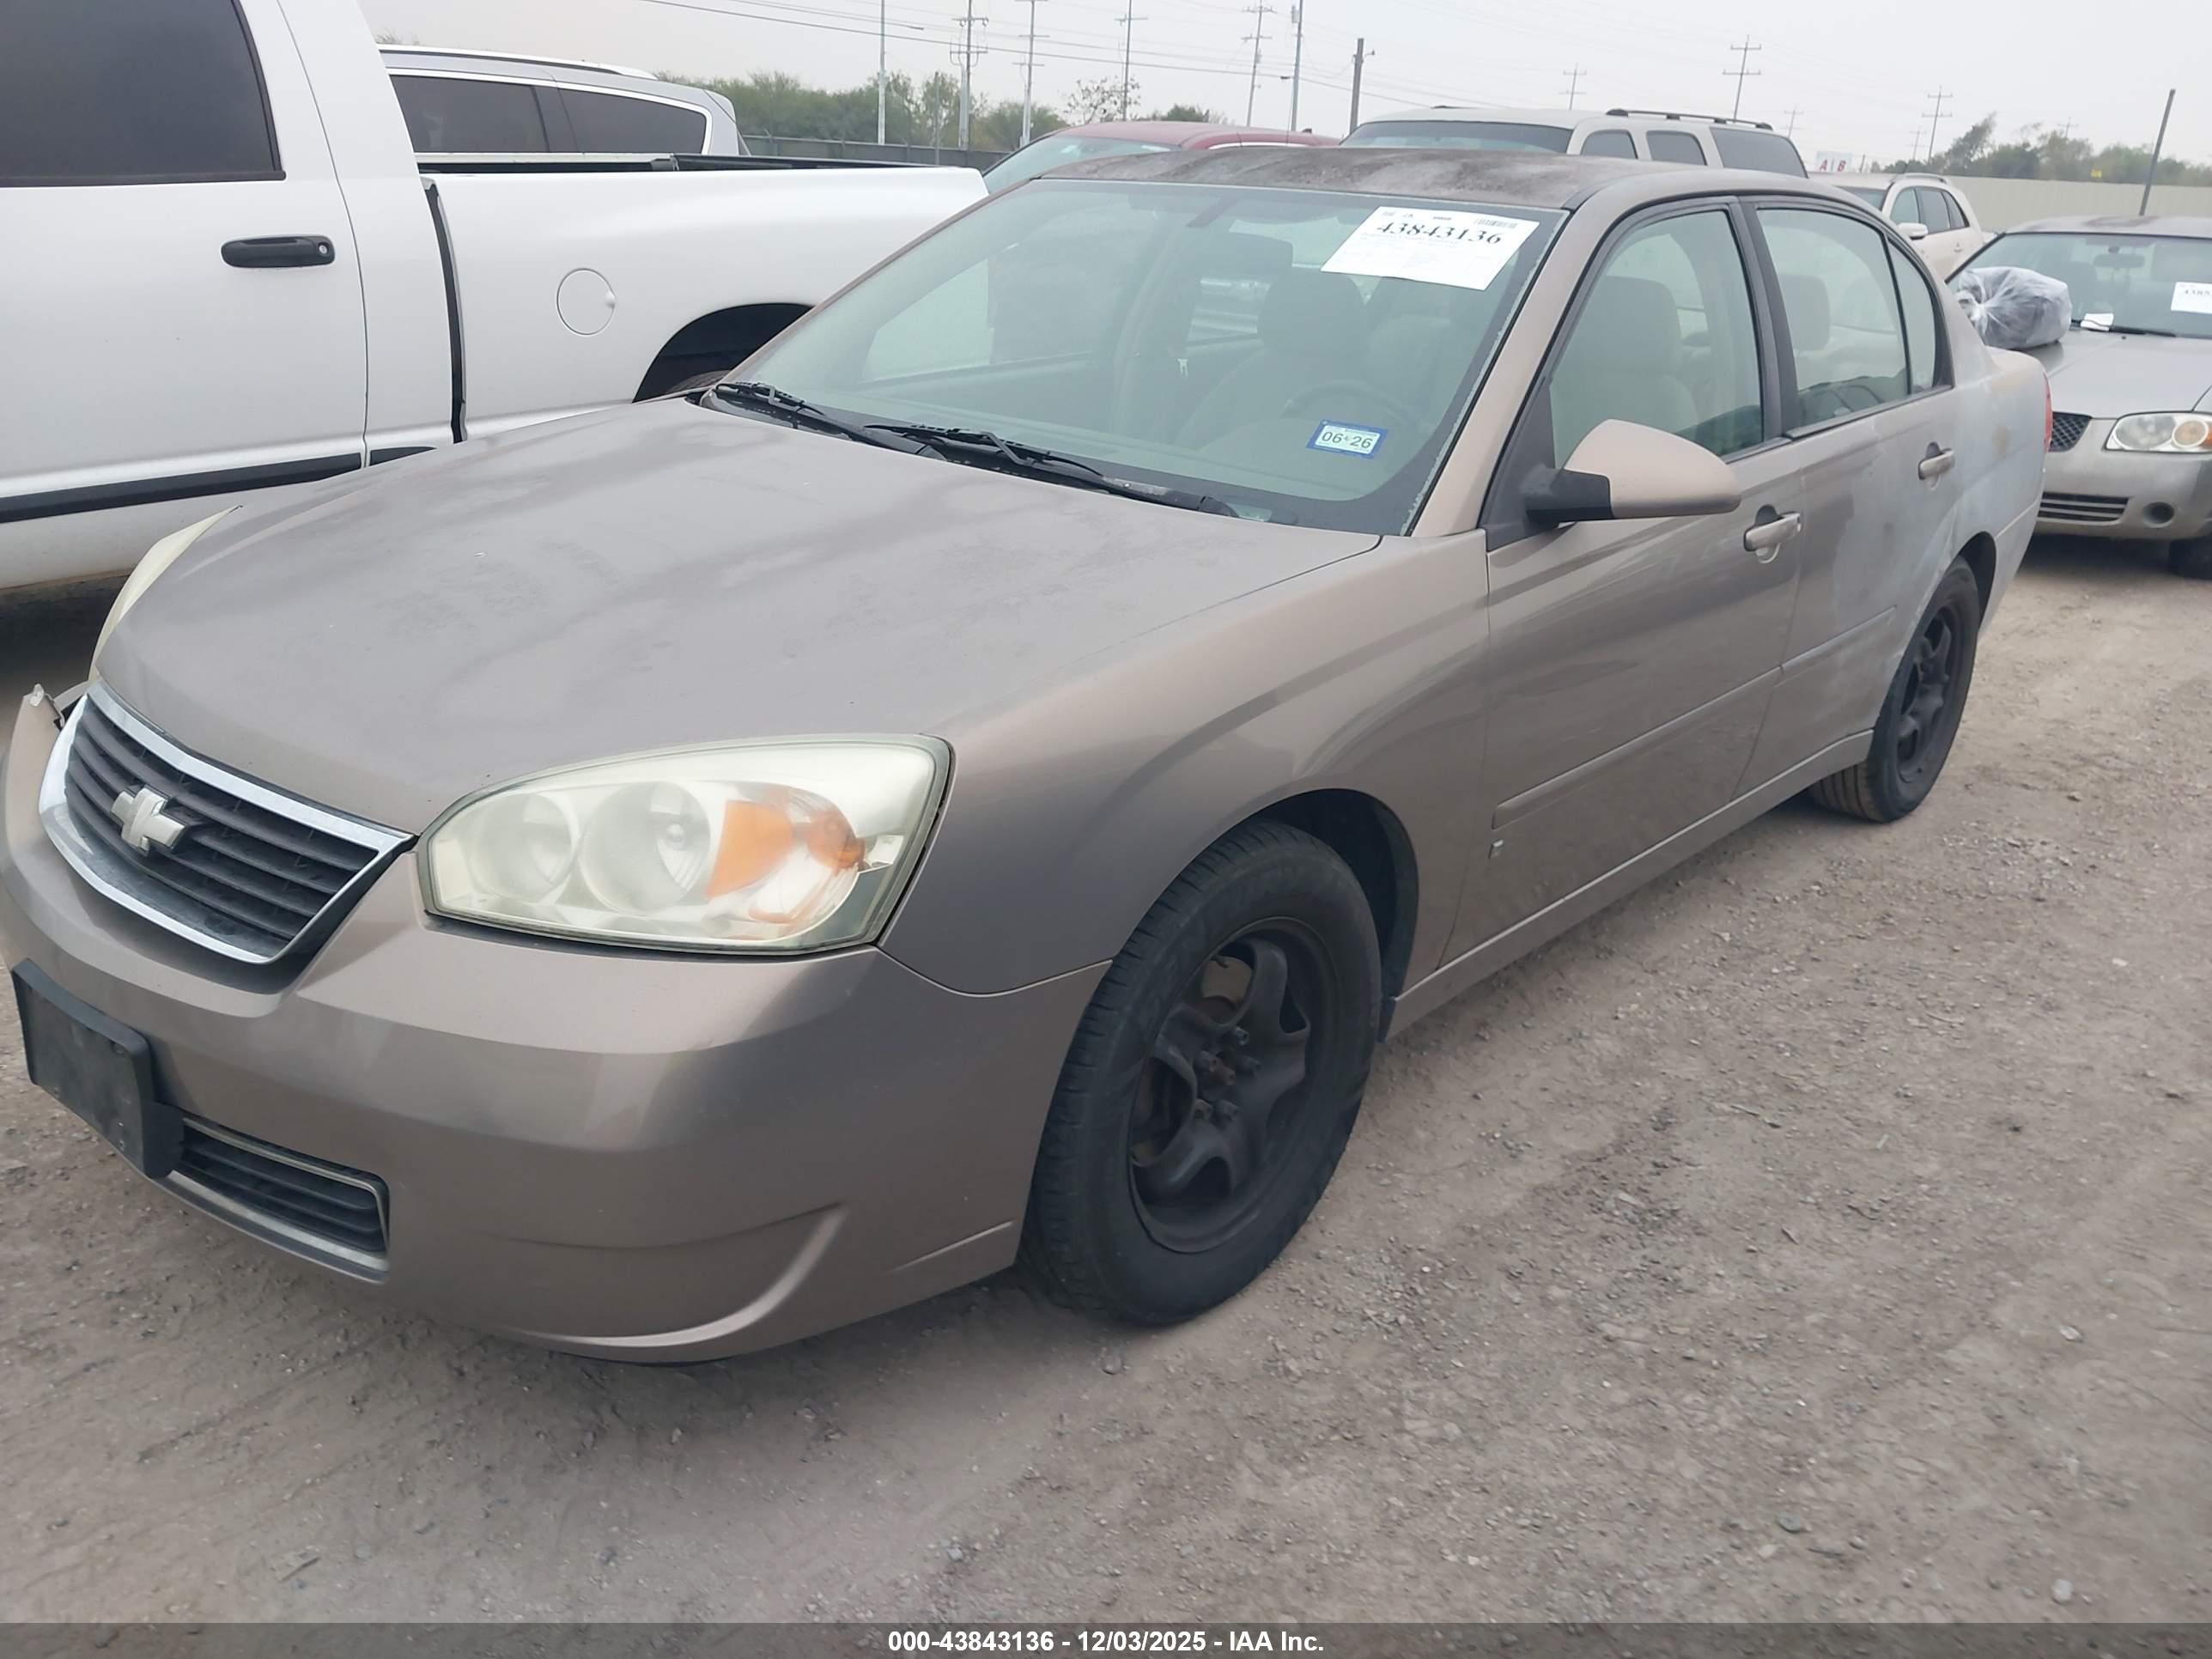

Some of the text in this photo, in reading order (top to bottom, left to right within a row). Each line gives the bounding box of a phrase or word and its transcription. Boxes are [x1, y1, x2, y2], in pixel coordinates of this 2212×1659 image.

[1376, 222, 1502, 244] 43843136
[1322, 431, 1373, 449] 06 26
